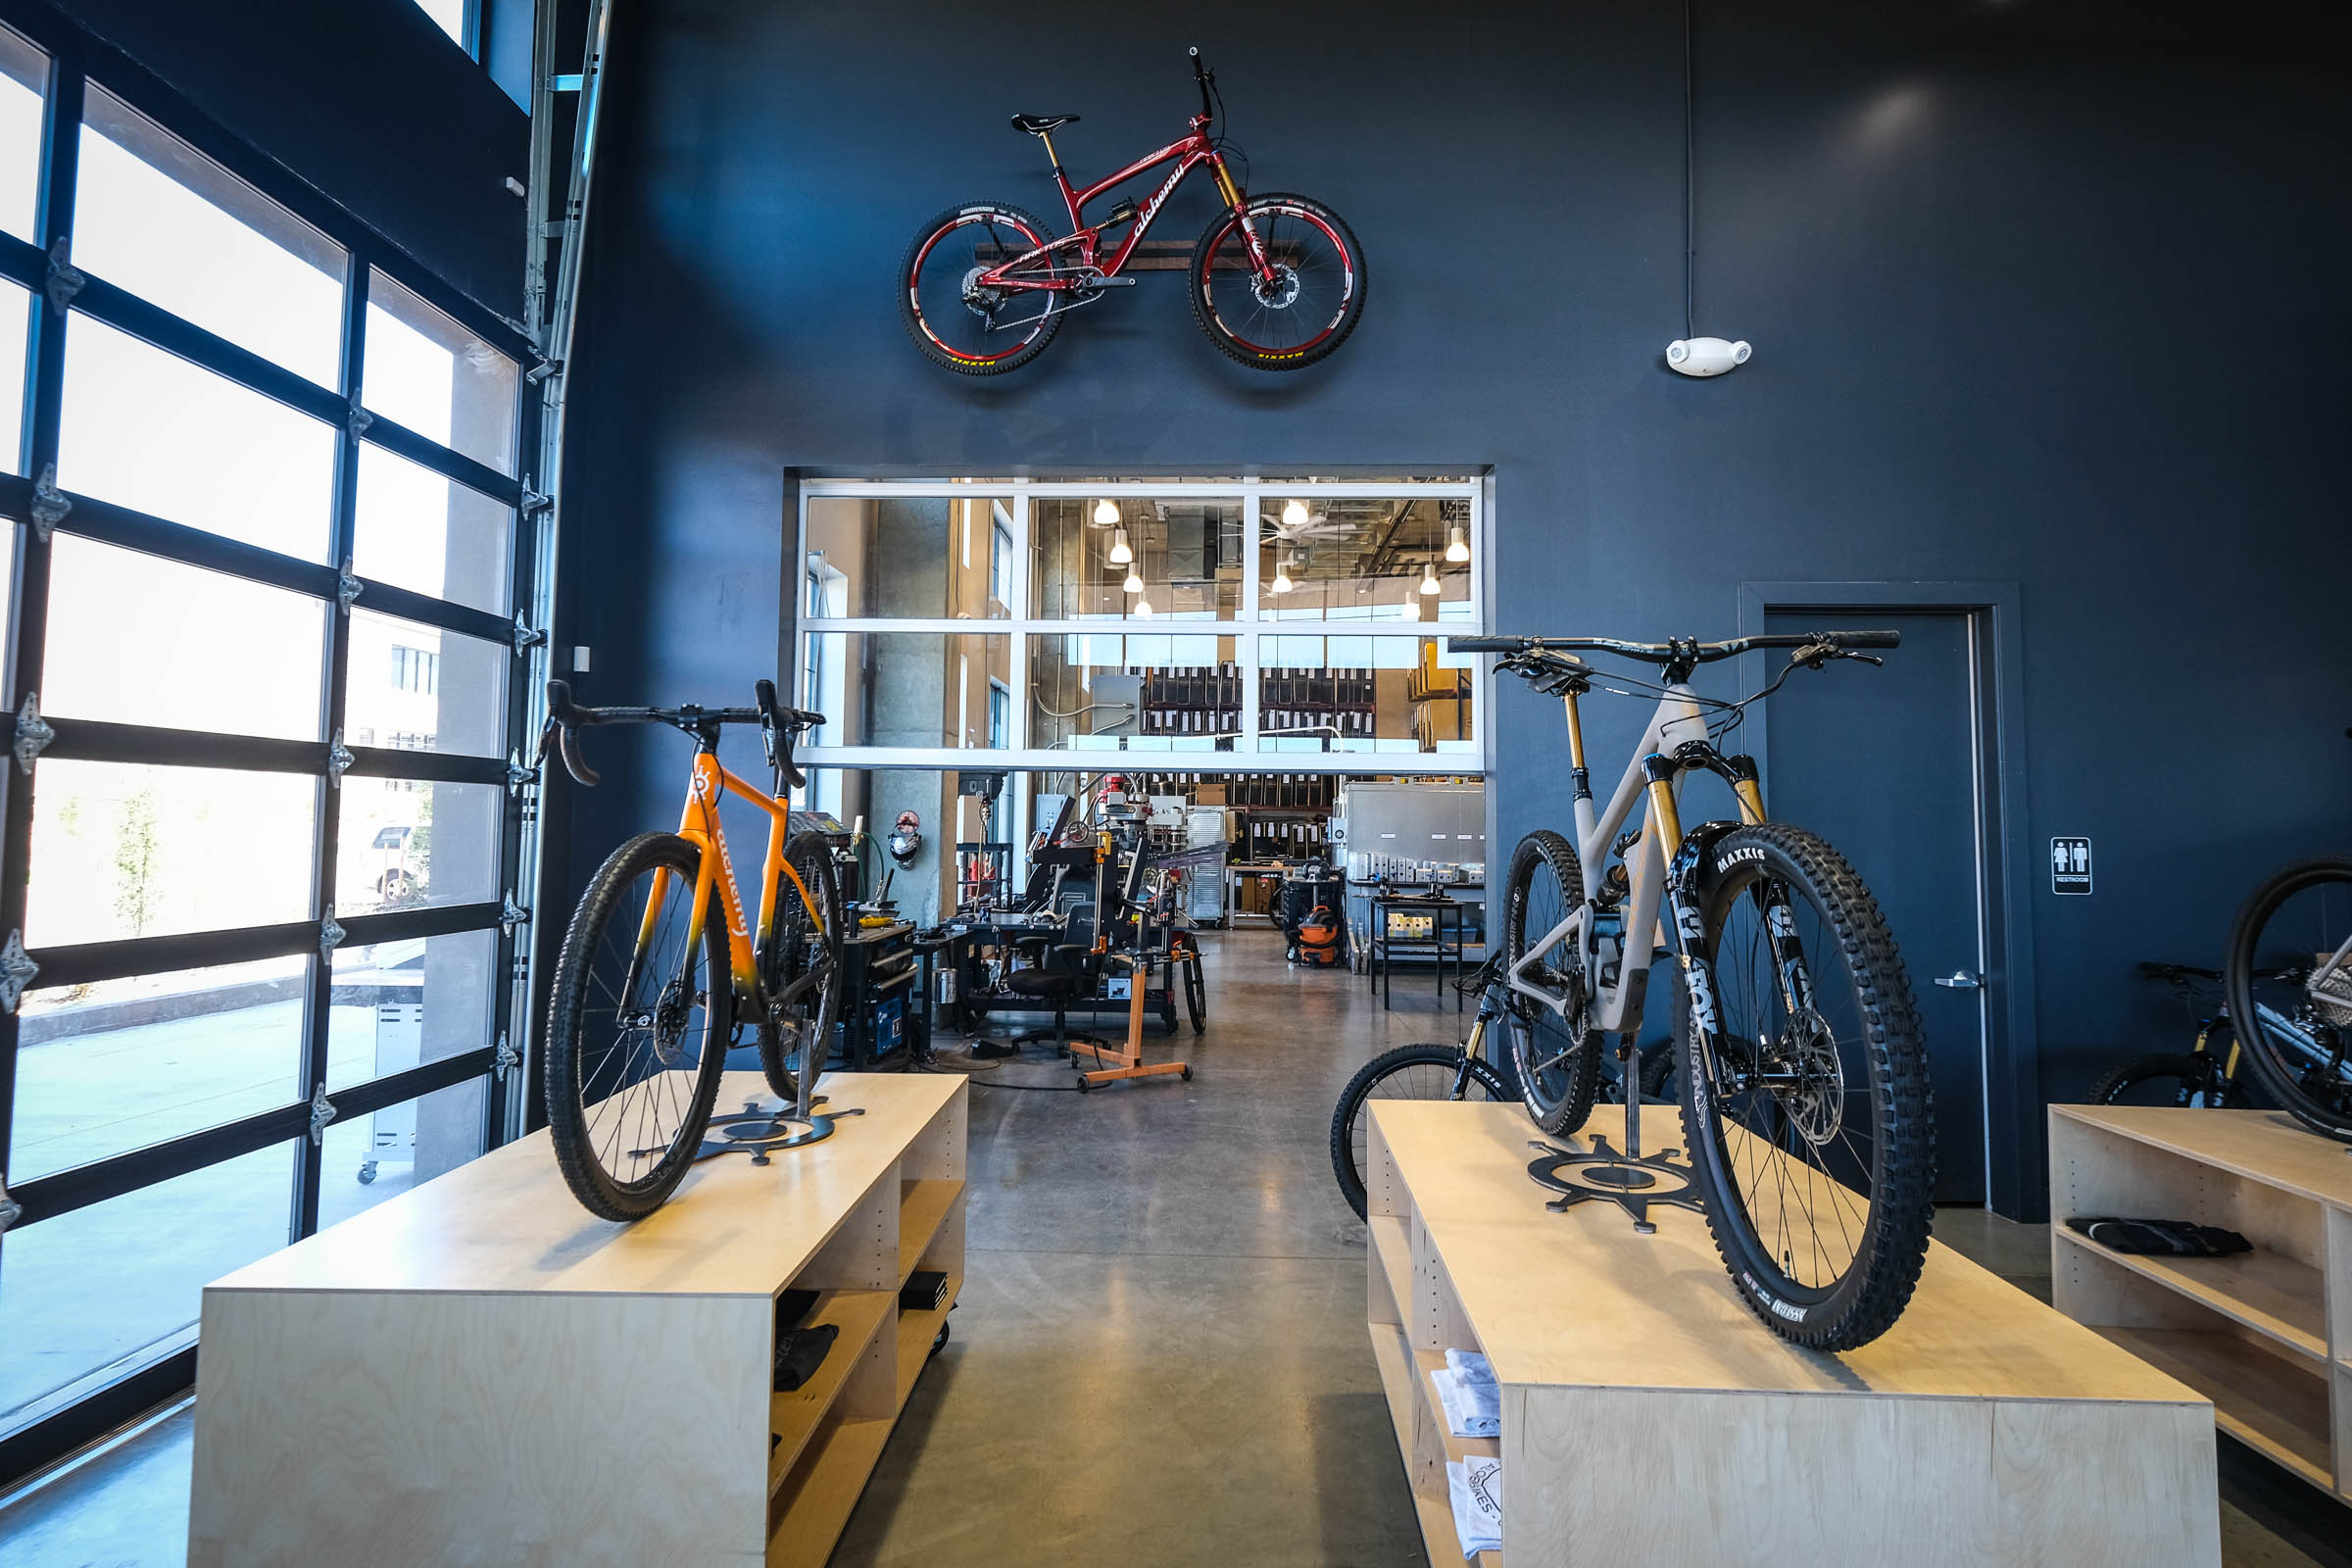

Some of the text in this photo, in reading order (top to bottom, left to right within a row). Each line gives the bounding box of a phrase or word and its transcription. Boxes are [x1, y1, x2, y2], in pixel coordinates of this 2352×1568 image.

[1134, 163, 1185, 238] alchemy
[1018, 239, 1067, 264] ARKTOS
[951, 357, 996, 367] MAXXIS
[1257, 351, 1304, 360] MAXXIS
[1717, 847, 1765, 873] MAXXIS
[1685, 968, 1718, 1035] FOX
[1688, 1030, 1703, 1096] INDUSTRY
[1472, 1065, 1501, 1089] XXIS
